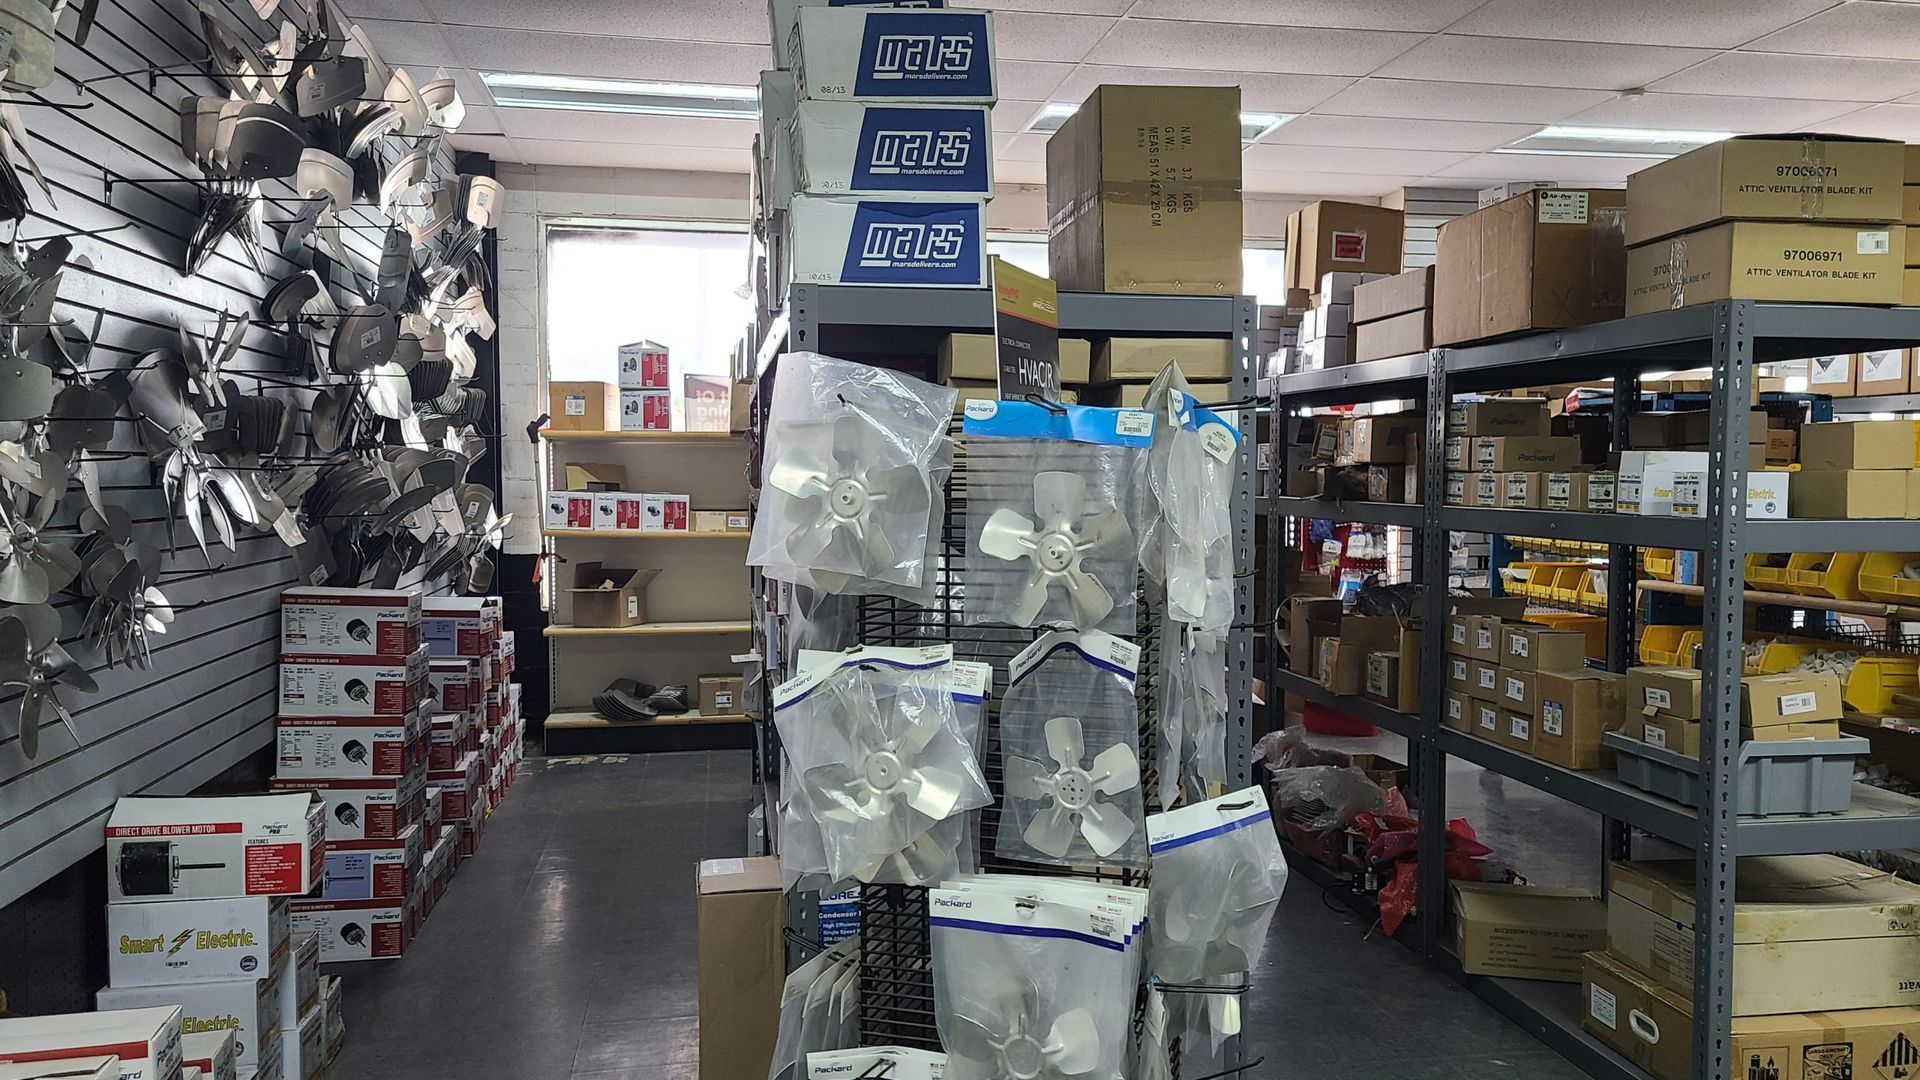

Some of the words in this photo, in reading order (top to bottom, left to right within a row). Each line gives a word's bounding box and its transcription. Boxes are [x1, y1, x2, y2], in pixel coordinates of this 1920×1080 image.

[904, 72, 968, 80] marsdelivers.com
[821, 86, 846, 94] 08/13
[1148, 127, 1159, 156] MEAS:
[1150, 158, 1159, 168] 51
[1166, 167, 1176, 181] 5.7
[1182, 167, 1192, 180] 3.7
[1738, 185, 1764, 193] ATTIC
[1768, 185, 1824, 194] VENTILATOR
[1826, 186, 1856, 195] BLADE
[1859, 186, 1873, 195] KIT
[1151, 201, 1161, 210] 29
[1167, 193, 1177, 214] KGS
[1183, 193, 1193, 213] KGS
[1152, 213, 1161, 227] CM
[1783, 250, 1843, 262] 97006971
[1746, 268, 1772, 276] ATTIC
[1776, 268, 1828, 278] VENTILATOR
[1831, 270, 1861, 279] BLADE
[1862, 271, 1877, 280] KIT
[966, 406, 994, 414] Packard
[1016, 644, 1043, 671] Packard
[779, 674, 813, 696] Packard
[116, 826, 139, 837] DIRECT
[141, 826, 161, 836] DRIVE
[162, 825, 191, 835] BLOWER
[192, 824, 216, 834] MOTOR
[934, 896, 972, 910] Packard
[120, 933, 164, 954] Smart
[196, 928, 253, 950] Electric
[814, 1064, 852, 1073] Packard
